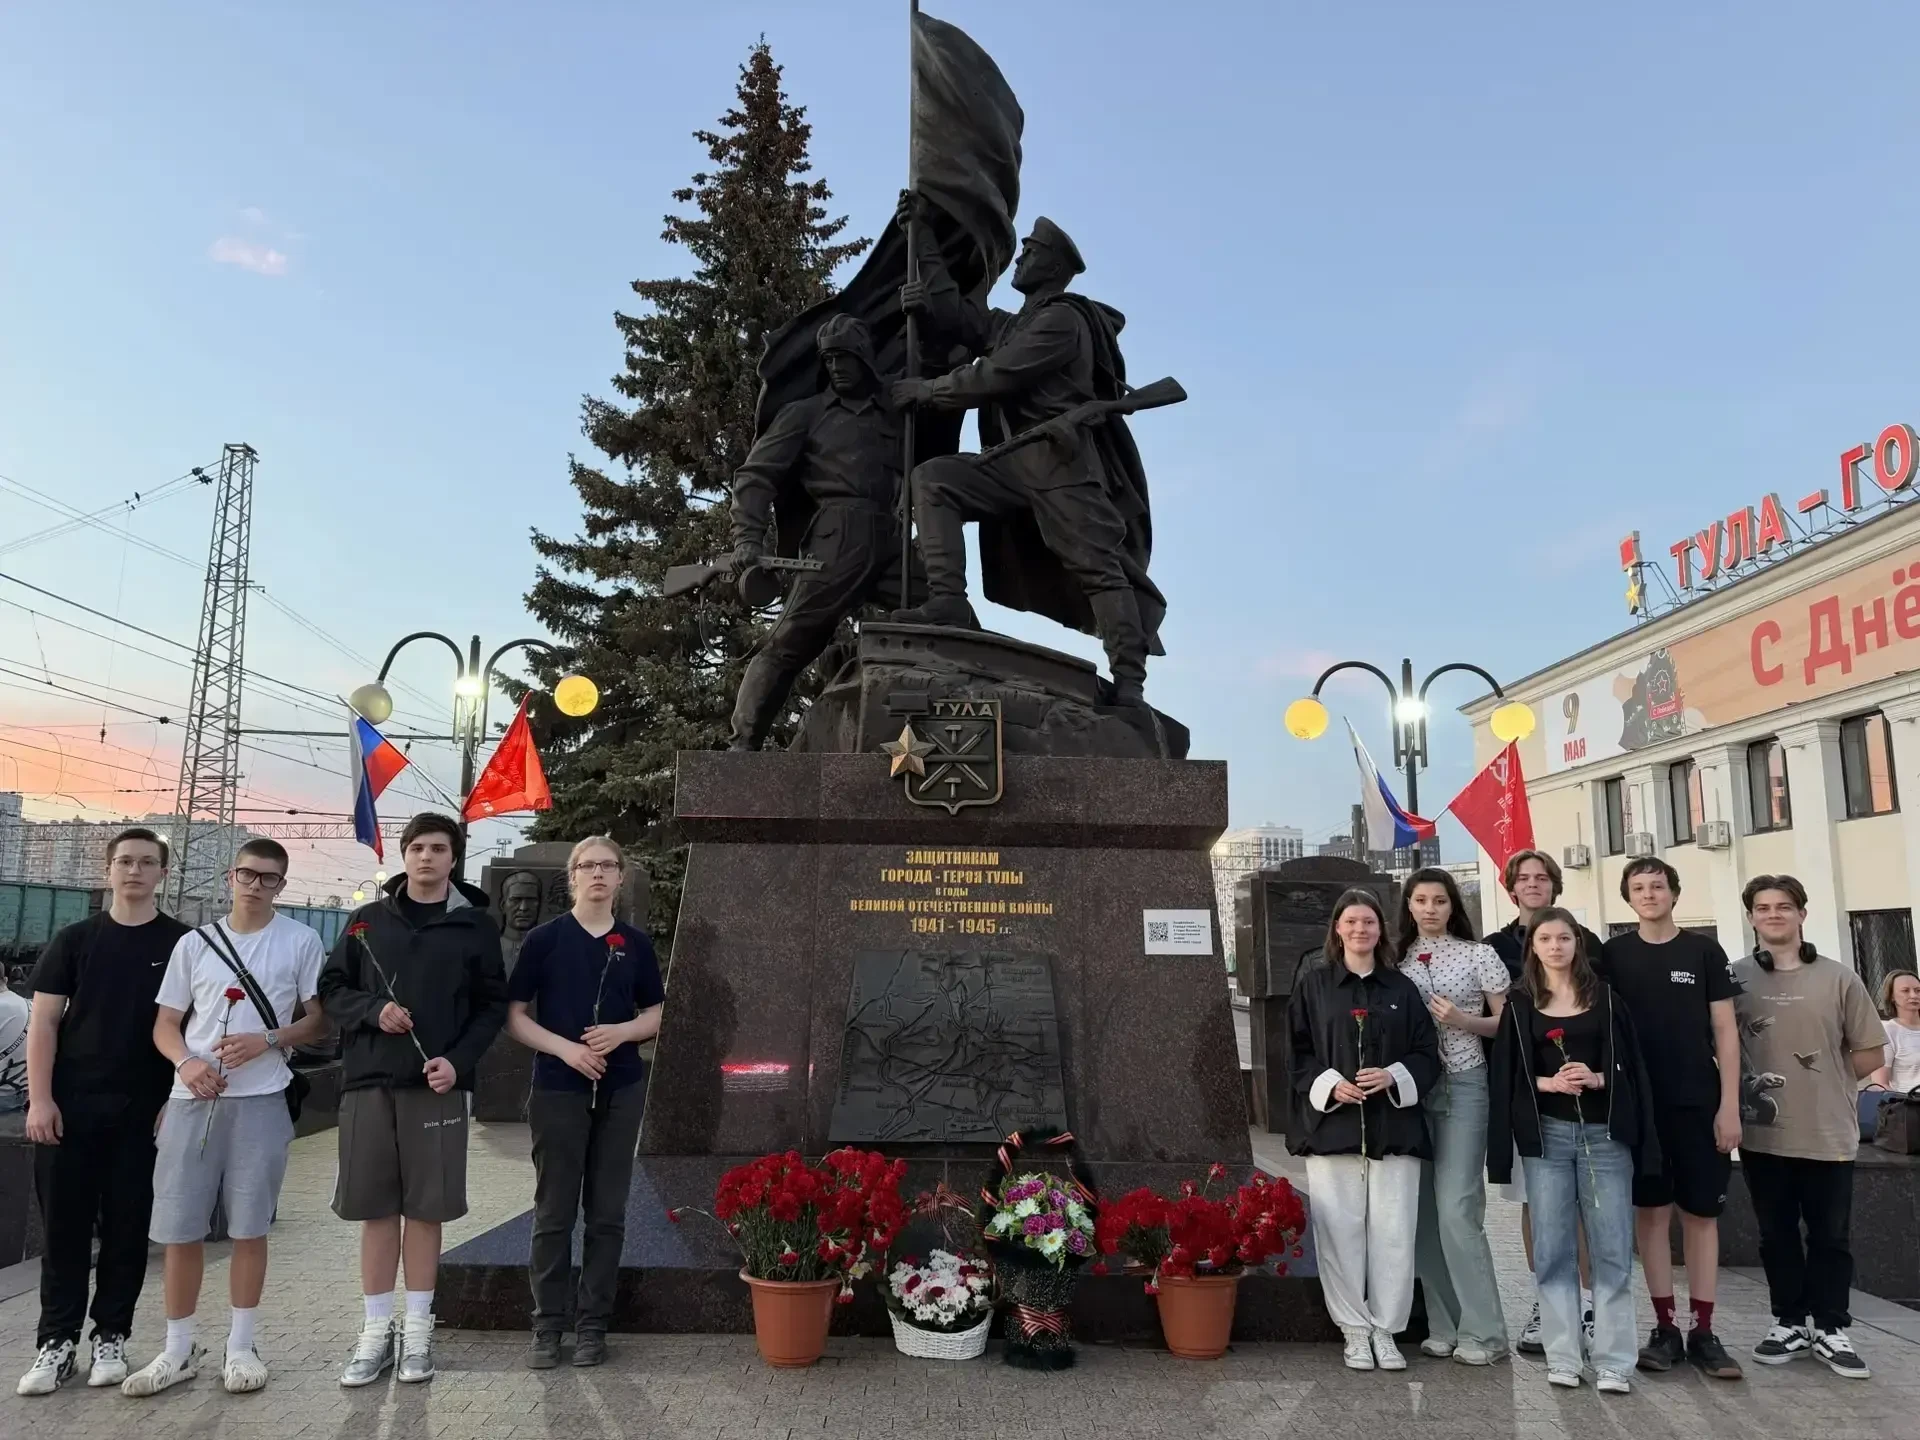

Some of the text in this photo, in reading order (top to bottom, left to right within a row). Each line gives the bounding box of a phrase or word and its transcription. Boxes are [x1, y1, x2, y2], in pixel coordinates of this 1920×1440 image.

[933, 702, 994, 717] ТУЛА
[1562, 692, 1580, 735] 9
[1563, 737, 1587, 763] МАЯ
[905, 850, 999, 866] ЗАЩИТНИКАМ
[880, 868, 933, 885] ГОРОДА
[943, 869, 983, 884] ГЕРОЯ
[985, 870, 1024, 885] ТУЛЫ
[850, 898, 1053, 915] ВЕЛИКОЙ ОТЕЧЕСТВЕННОЙ ВОЙНЫ
[910, 917, 945, 933] 1941
[957, 918, 996, 934] 1945
[1671, 970, 1690, 978] ЦЕНТР
[1671, 977, 1695, 985] СПОРТА
